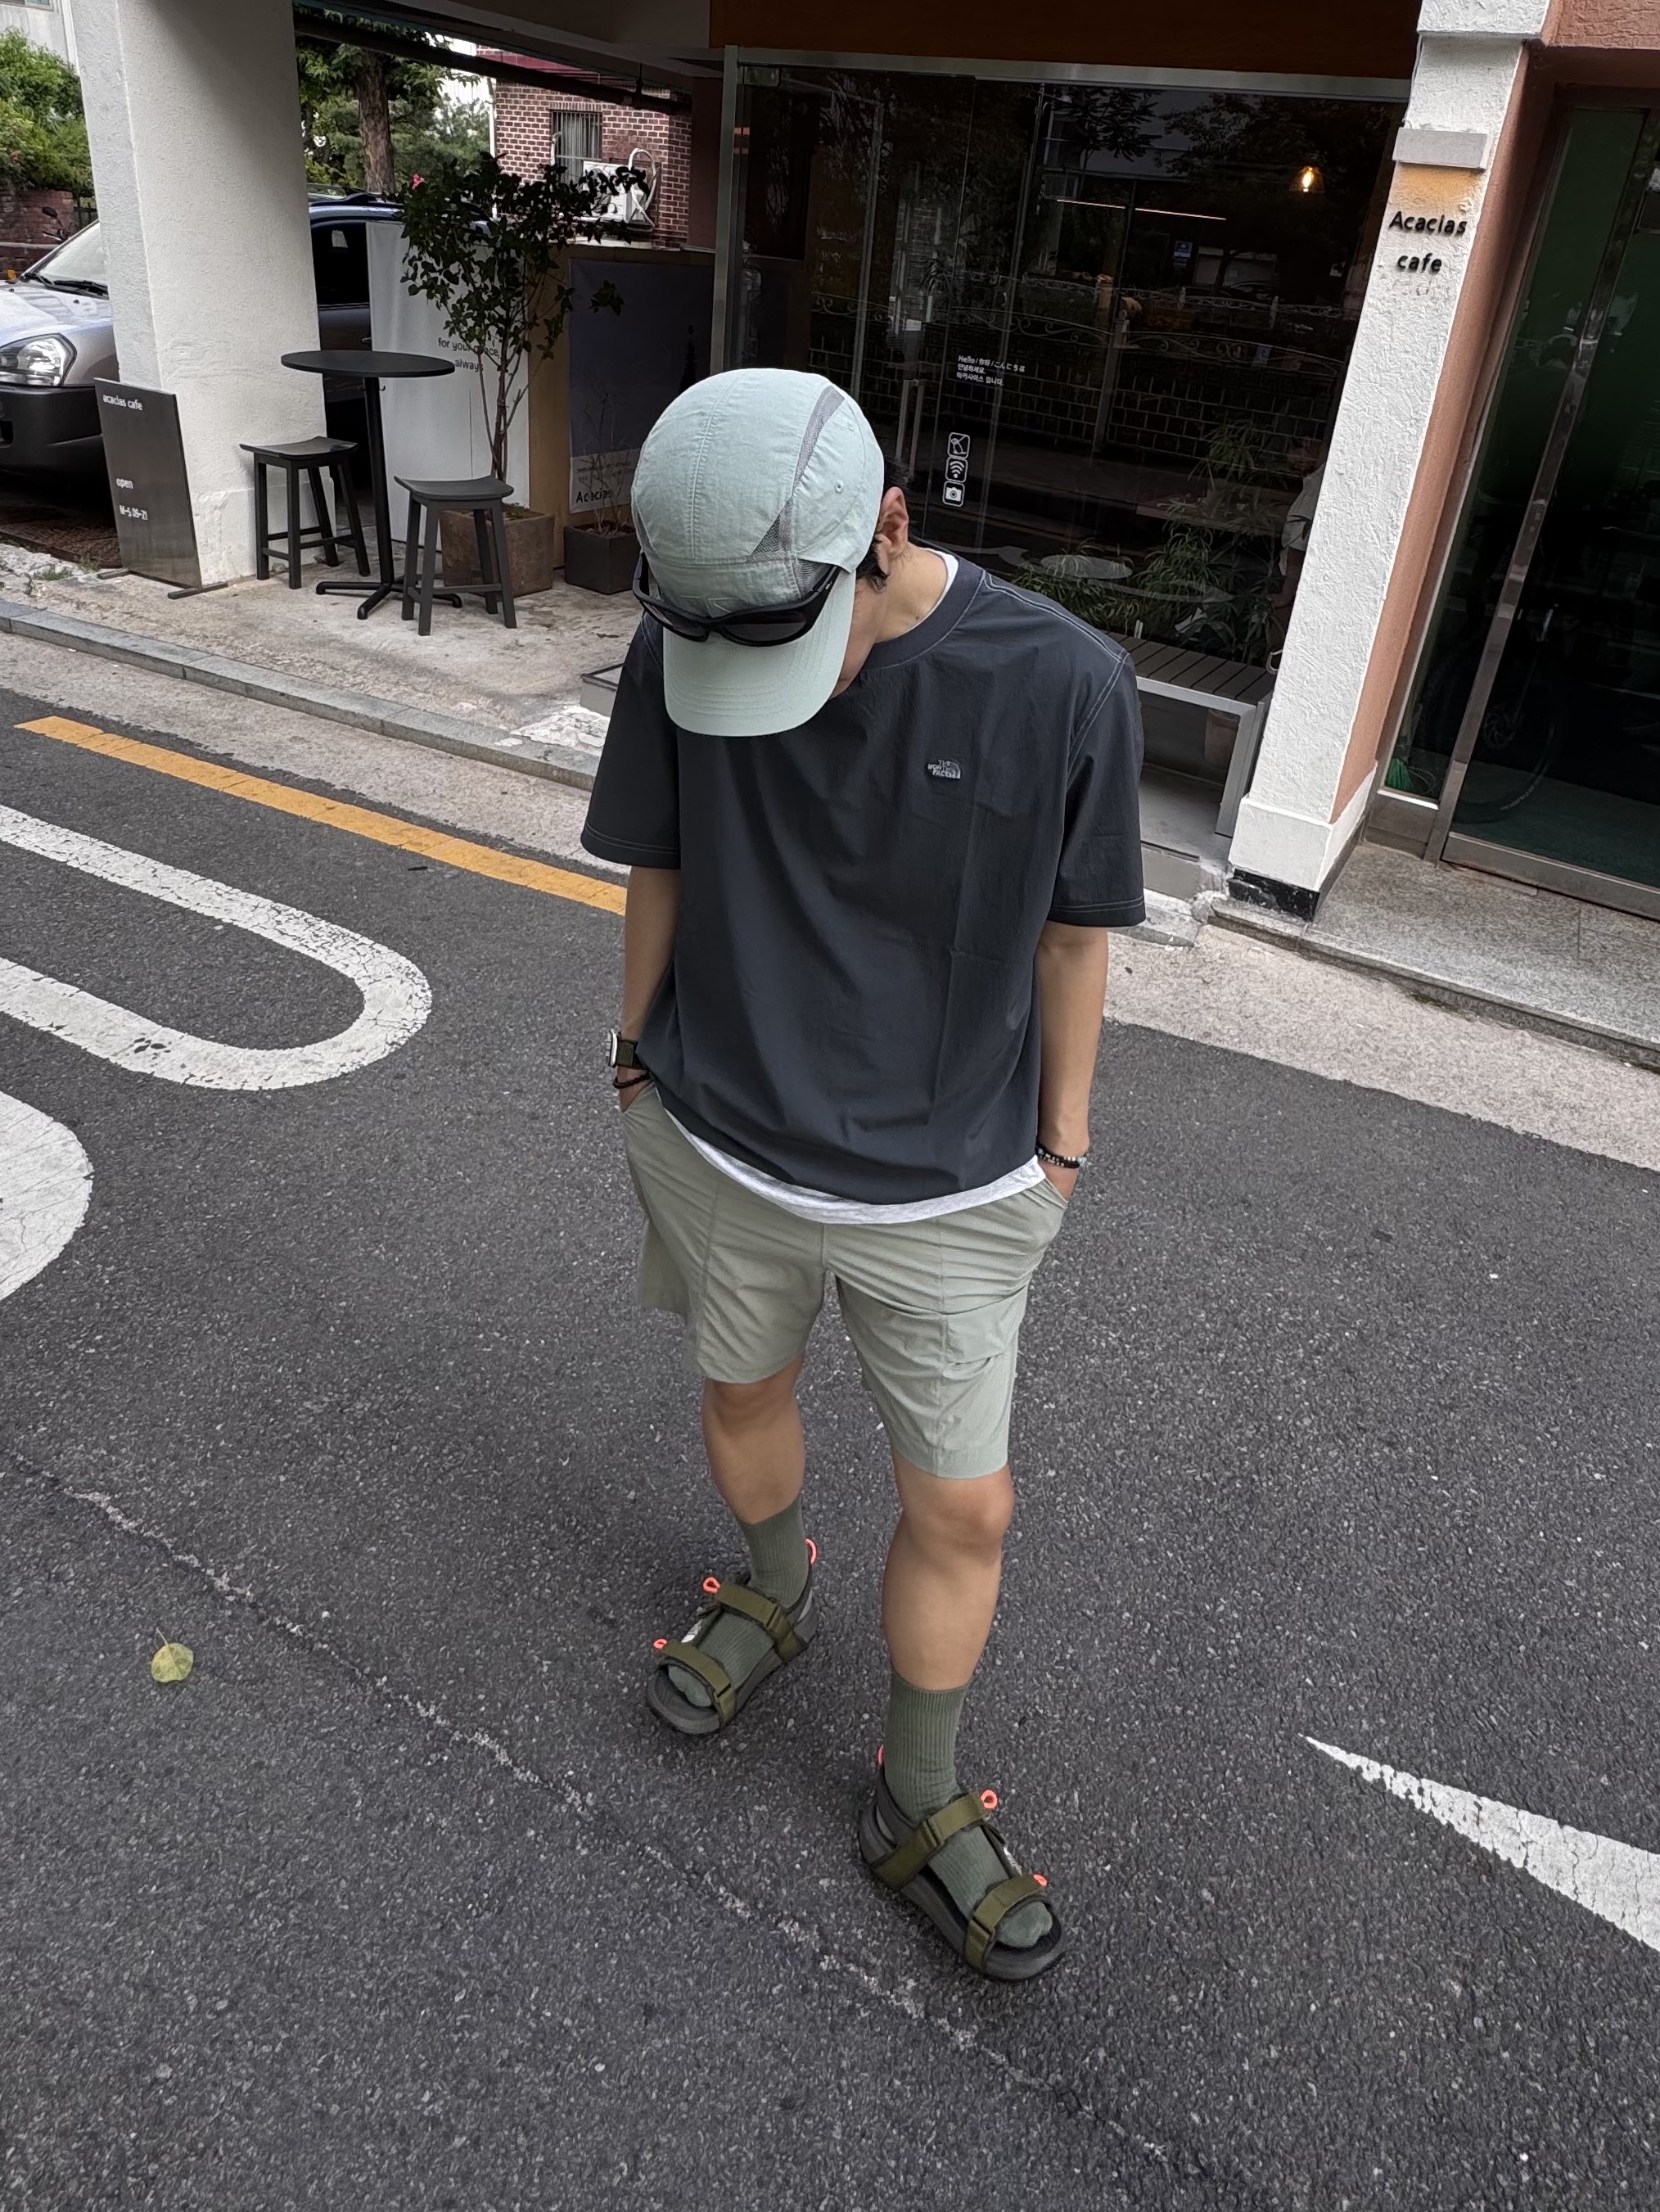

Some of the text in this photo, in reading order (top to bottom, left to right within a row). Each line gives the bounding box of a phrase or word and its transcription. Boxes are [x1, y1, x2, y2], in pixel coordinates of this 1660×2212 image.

[1389, 210, 1468, 235] Acacias
[1397, 252, 1442, 273] cafe
[438, 337, 450, 348] for
[474, 345, 500, 359] pace,
[958, 354, 975, 363] Hello
[994, 361, 1025, 372] こんにちは
[102, 395, 143, 410] acacias cafe
[116, 478, 133, 489] open
